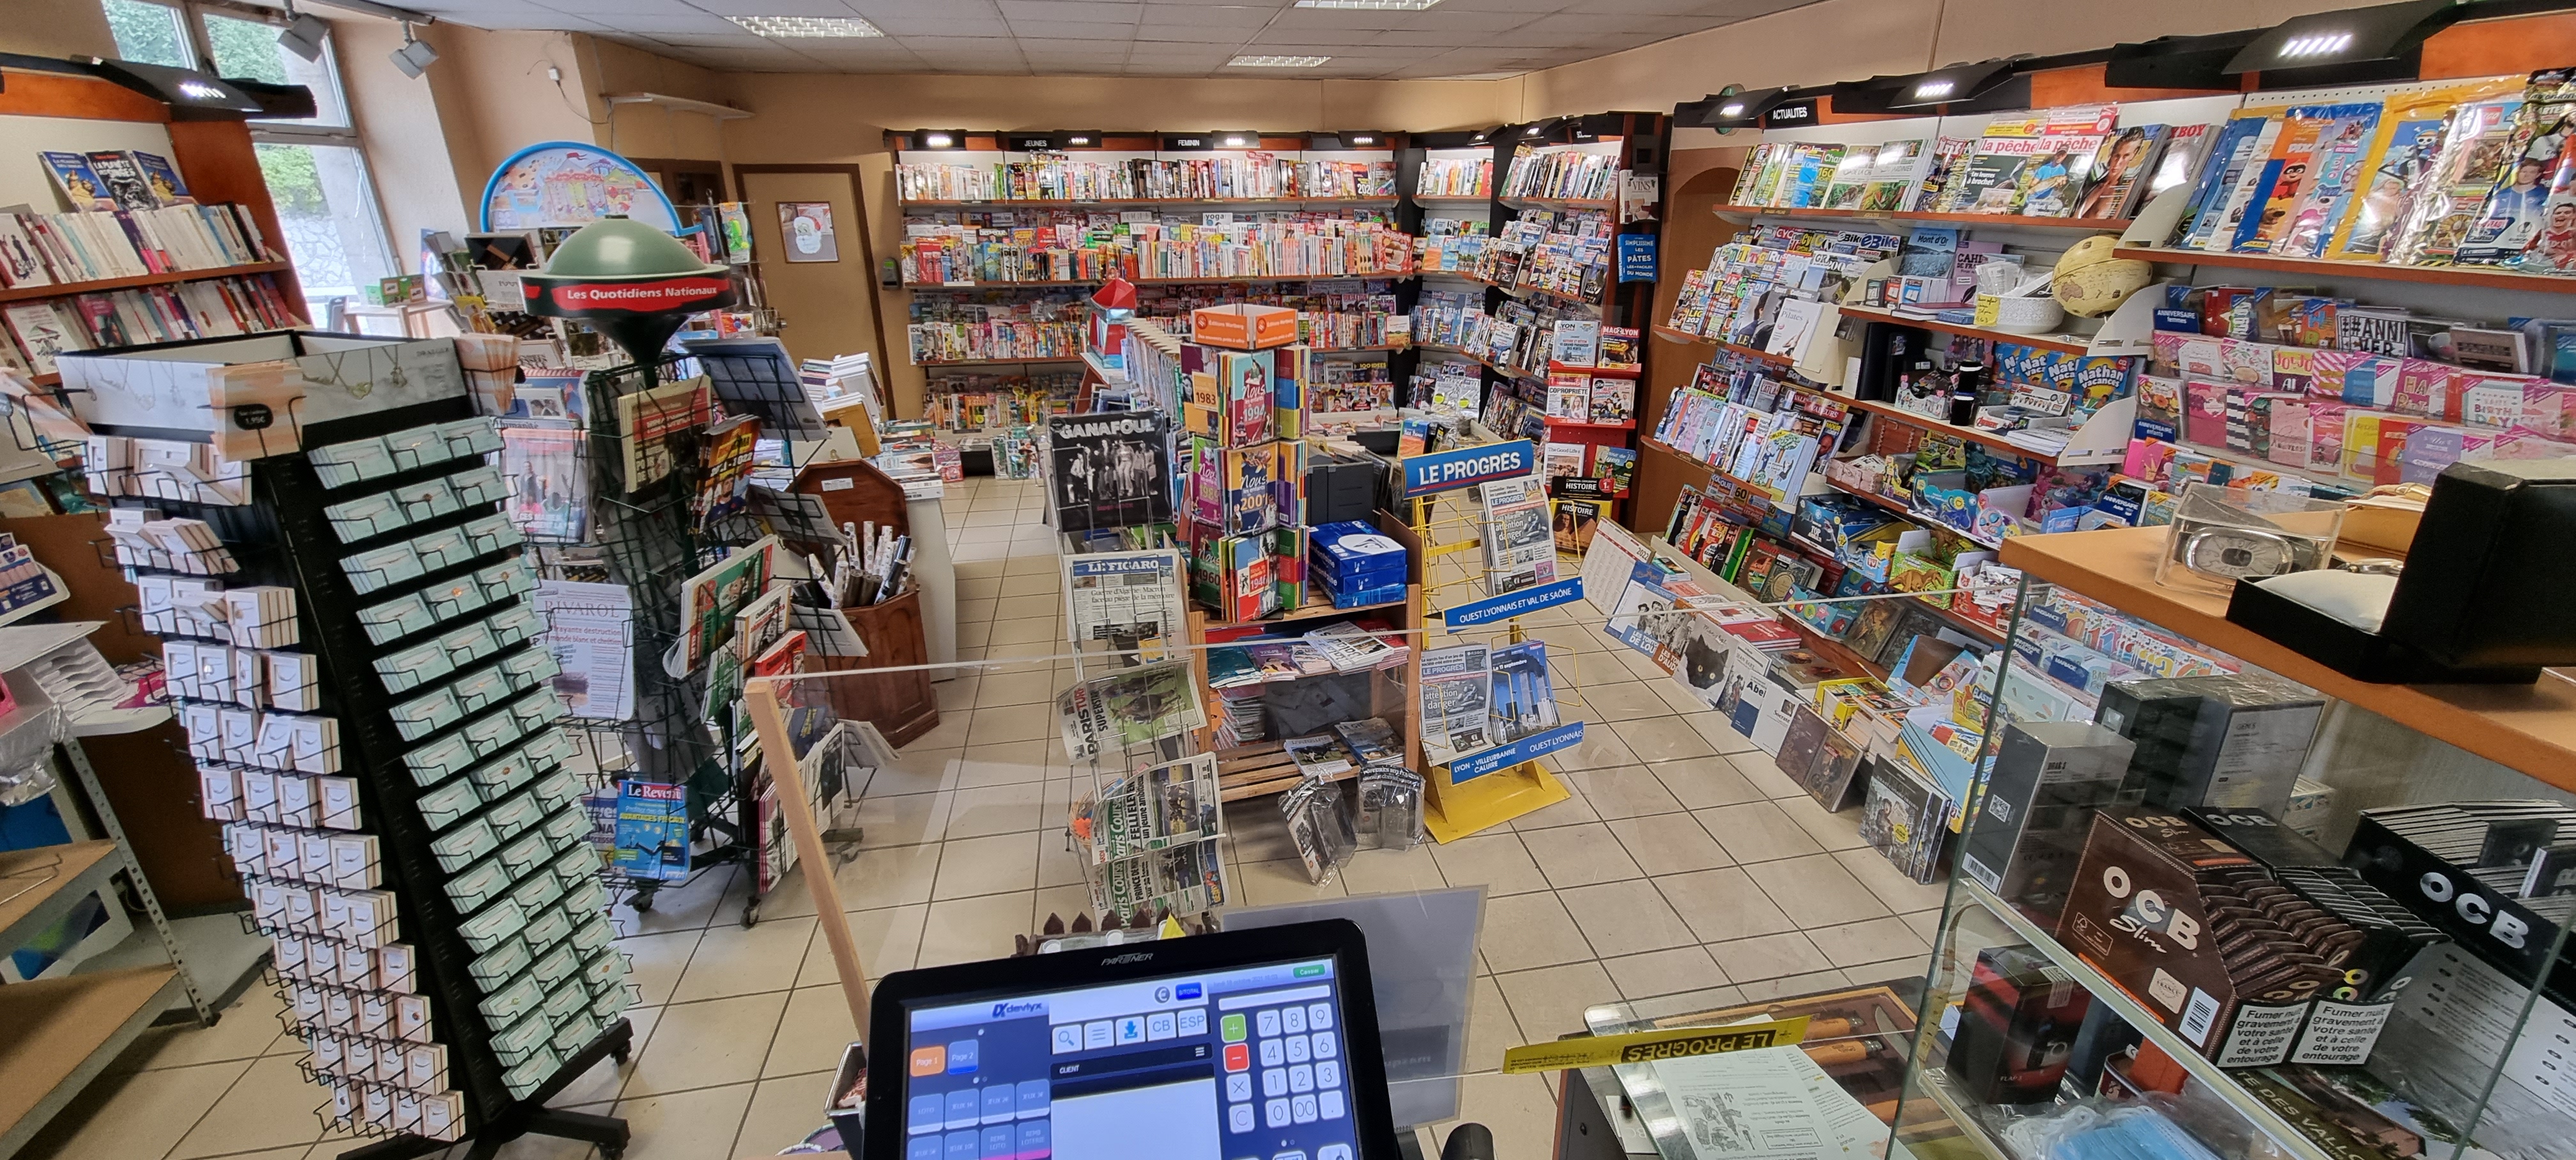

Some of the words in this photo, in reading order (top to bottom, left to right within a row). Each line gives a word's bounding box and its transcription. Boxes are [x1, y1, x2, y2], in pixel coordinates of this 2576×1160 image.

[1982, 141, 1992, 151] la
[1995, 139, 2037, 154] pêche
[2039, 137, 2050, 150] la
[2053, 138, 2097, 153] pêche
[1632, 181, 1651, 191] VINS
[1917, 235, 1933, 243] Mont
[567, 289, 586, 300] Les
[590, 287, 661, 299] Quotidiens
[666, 286, 717, 297] Nationaux
[1781, 311, 1804, 321] Pilates
[2157, 310, 2195, 319] ANNIVERSAIRE
[1603, 326, 1639, 336] MAG2LYON
[1737, 334, 1749, 346] LE
[2078, 365, 2124, 384] Nathan
[2081, 378, 2120, 388] vacances
[1196, 392, 1216, 404] 1983
[1242, 384, 1266, 399] Nous
[1243, 405, 1266, 421] 1994
[1059, 418, 1154, 439] GANAFOUL
[1419, 465, 1439, 485] LE
[1443, 452, 1521, 479] PROGRÈS
[1239, 475, 1268, 489] Nous
[1735, 487, 1747, 500] 60
[1491, 498, 1498, 507] LE
[1498, 494, 1524, 505] PROGRÈS
[1561, 504, 1593, 515] HISTOIRE
[1496, 519, 1524, 531] attention
[1499, 530, 1523, 540] danger
[1637, 547, 1649, 560] 2022
[1108, 560, 1159, 572] FIGARO
[1199, 569, 1220, 586] 1960
[544, 600, 619, 618] RIVAROL
[1459, 610, 1482, 623] OUEST
[1483, 602, 1517, 617] LYONNAIS
[1518, 600, 1526, 608] ET
[1527, 597, 1539, 606] VAL
[1550, 588, 1572, 600] SAÔNE
[1629, 636, 1639, 646] DE
[1640, 641, 1655, 653] LOU
[1432, 664, 1464, 674] PROGRÈS
[1504, 659, 1527, 668] septembre
[1425, 690, 1457, 700] attention
[1428, 699, 1455, 710] danger
[1077, 710, 1096, 755] PARIS
[1529, 742, 1551, 752] OUEST
[1552, 729, 1583, 745] LYONNAIS
[1454, 763, 1470, 773] LYON
[1475, 747, 1516, 765] VILLEURBANNE
[1474, 761, 1498, 774] CALUIRE
[628, 784, 641, 796] Le
[2126, 816, 2188, 828] OCB
[2205, 814, 2277, 827] OCB
[1114, 834, 1128, 859] Paris
[2103, 866, 2201, 950] OCB
[2420, 872, 2529, 949] OCB
[2109, 914, 2167, 954] Slim
[2246, 1010, 2284, 1018] Fumer
[2322, 1006, 2363, 1018] Fumer
[1153, 1020, 1170, 1033] CB
[1180, 1015, 1205, 1029] ESP
[1264, 1016, 1273, 1031] 7
[1290, 1013, 1299, 1028] 8
[1315, 1009, 1325, 1024] 9
[2237, 1018, 2295, 1028] gravement
[2313, 1017, 2378, 1026] gravement
[2269, 1026, 2294, 1037] santé
[2313, 1026, 2345, 1035] votre
[2347, 1026, 2377, 1035] santé
[1741, 1032, 1769, 1048] LE
[1268, 1045, 1277, 1060] 4
[1293, 1042, 1302, 1057] 5
[1320, 1038, 1330, 1053] 6
[1627, 1034, 1735, 1062] PROGRÈS
[916, 1058, 931, 1067] Page
[951, 1053, 968, 1062] Page
[2227, 1054, 2278, 1063] entourage
[1059, 1065, 1080, 1074] CLIENT
[1273, 1075, 1278, 1090] 1
[1298, 1071, 1305, 1087] 2
[1324, 1067, 1333, 1083] 3
[2259, 1088, 2299, 1115] DES
[1235, 1110, 1247, 1126] C
[1273, 1105, 1284, 1121] 0
[1295, 1101, 1315, 1117] 00
